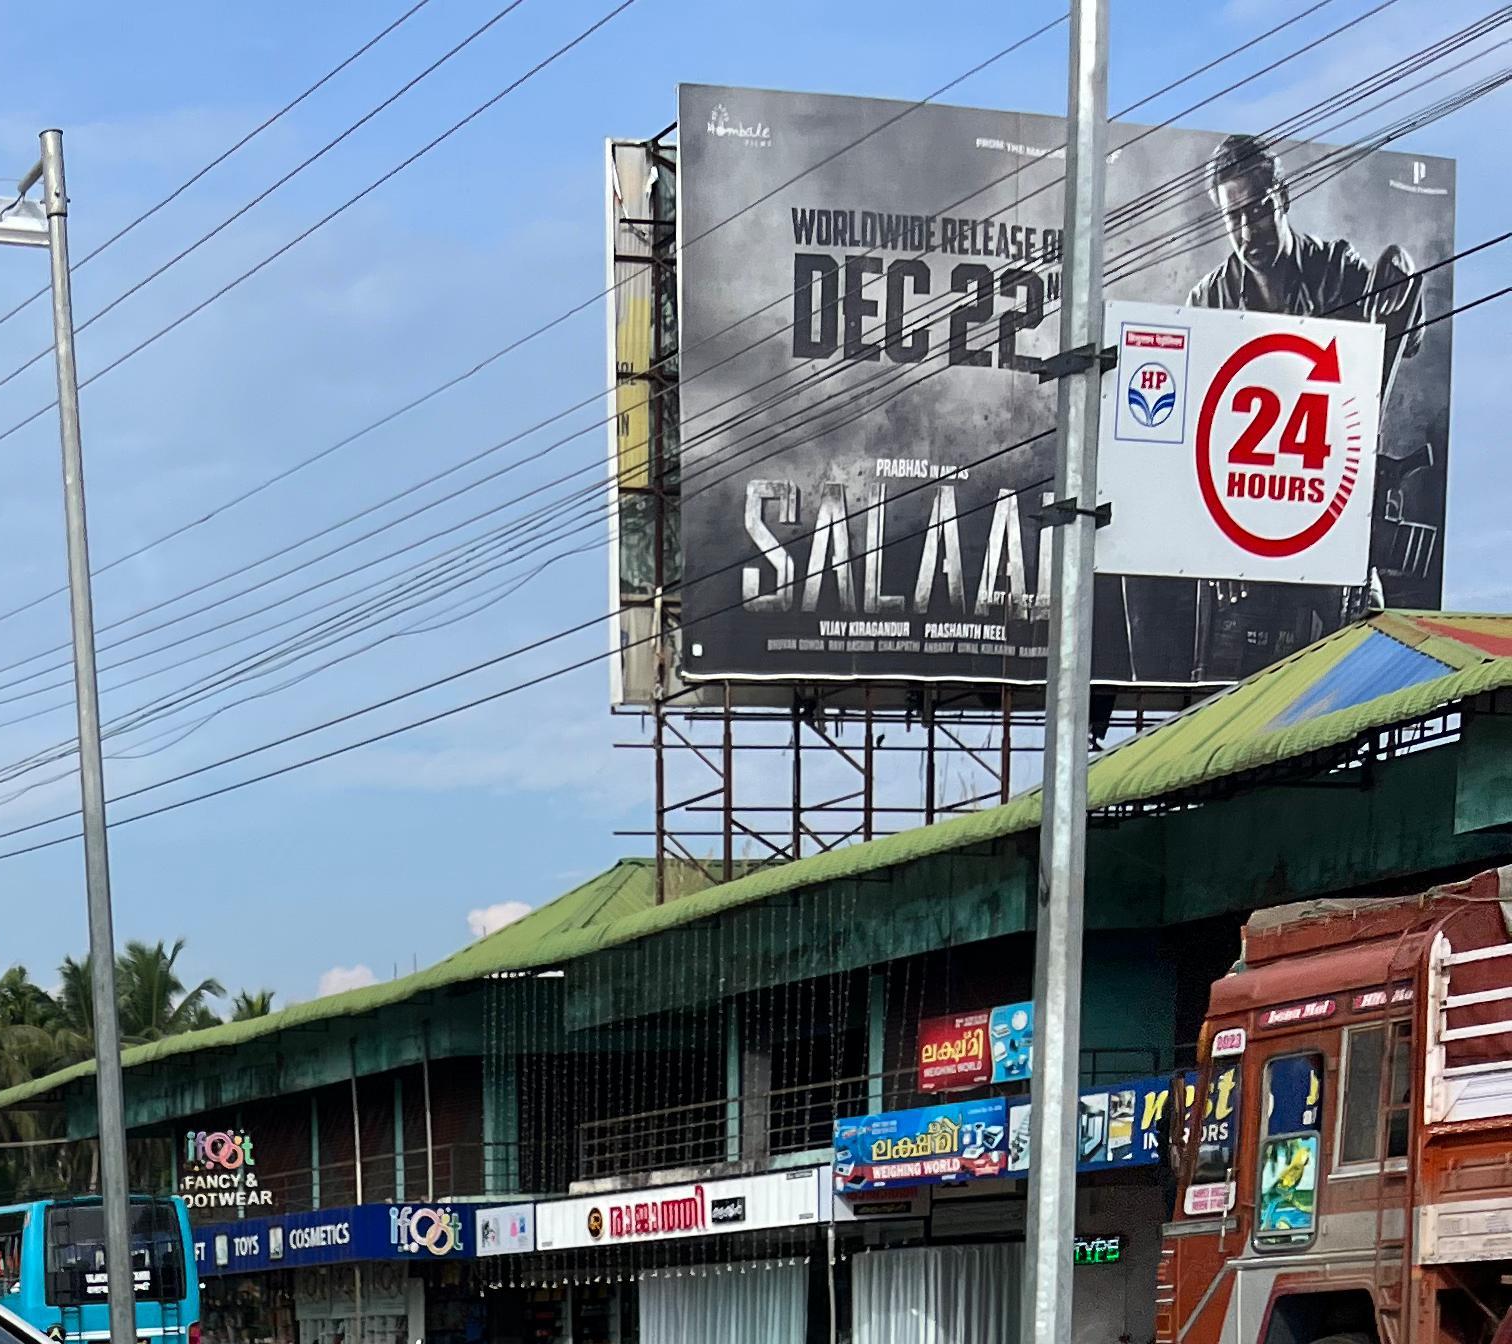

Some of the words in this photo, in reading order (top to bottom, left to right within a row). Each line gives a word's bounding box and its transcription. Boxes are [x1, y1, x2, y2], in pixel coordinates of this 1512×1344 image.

[975, 137, 1004, 150] FROM
[791, 207, 937, 252] WORLDWIDE
[941, 217, 1038, 262] RELEASE
[1041, 228, 1065, 264] O
[793, 253, 931, 363] DEC
[1140, 370, 1168, 390] HP
[1228, 386, 1331, 470] 24
[875, 458, 928, 479] PRABHAS
[1227, 472, 1325, 503] HOURS
[819, 620, 846, 637] VIJAY
[848, 621, 910, 637] KIRAGANDUR
[924, 622, 982, 640] PRASHANTH
[983, 625, 1007, 642] NEEL
[872, 1162, 922, 1179] WEIGHING
[923, 1158, 961, 1175] WORLD
[184, 1174, 241, 1190] FANCY
[245, 1172, 258, 1188] &
[182, 1190, 273, 1209] OOTWEAR
[233, 1234, 259, 1257] TOYS
[289, 1222, 350, 1250] COSMETICS
